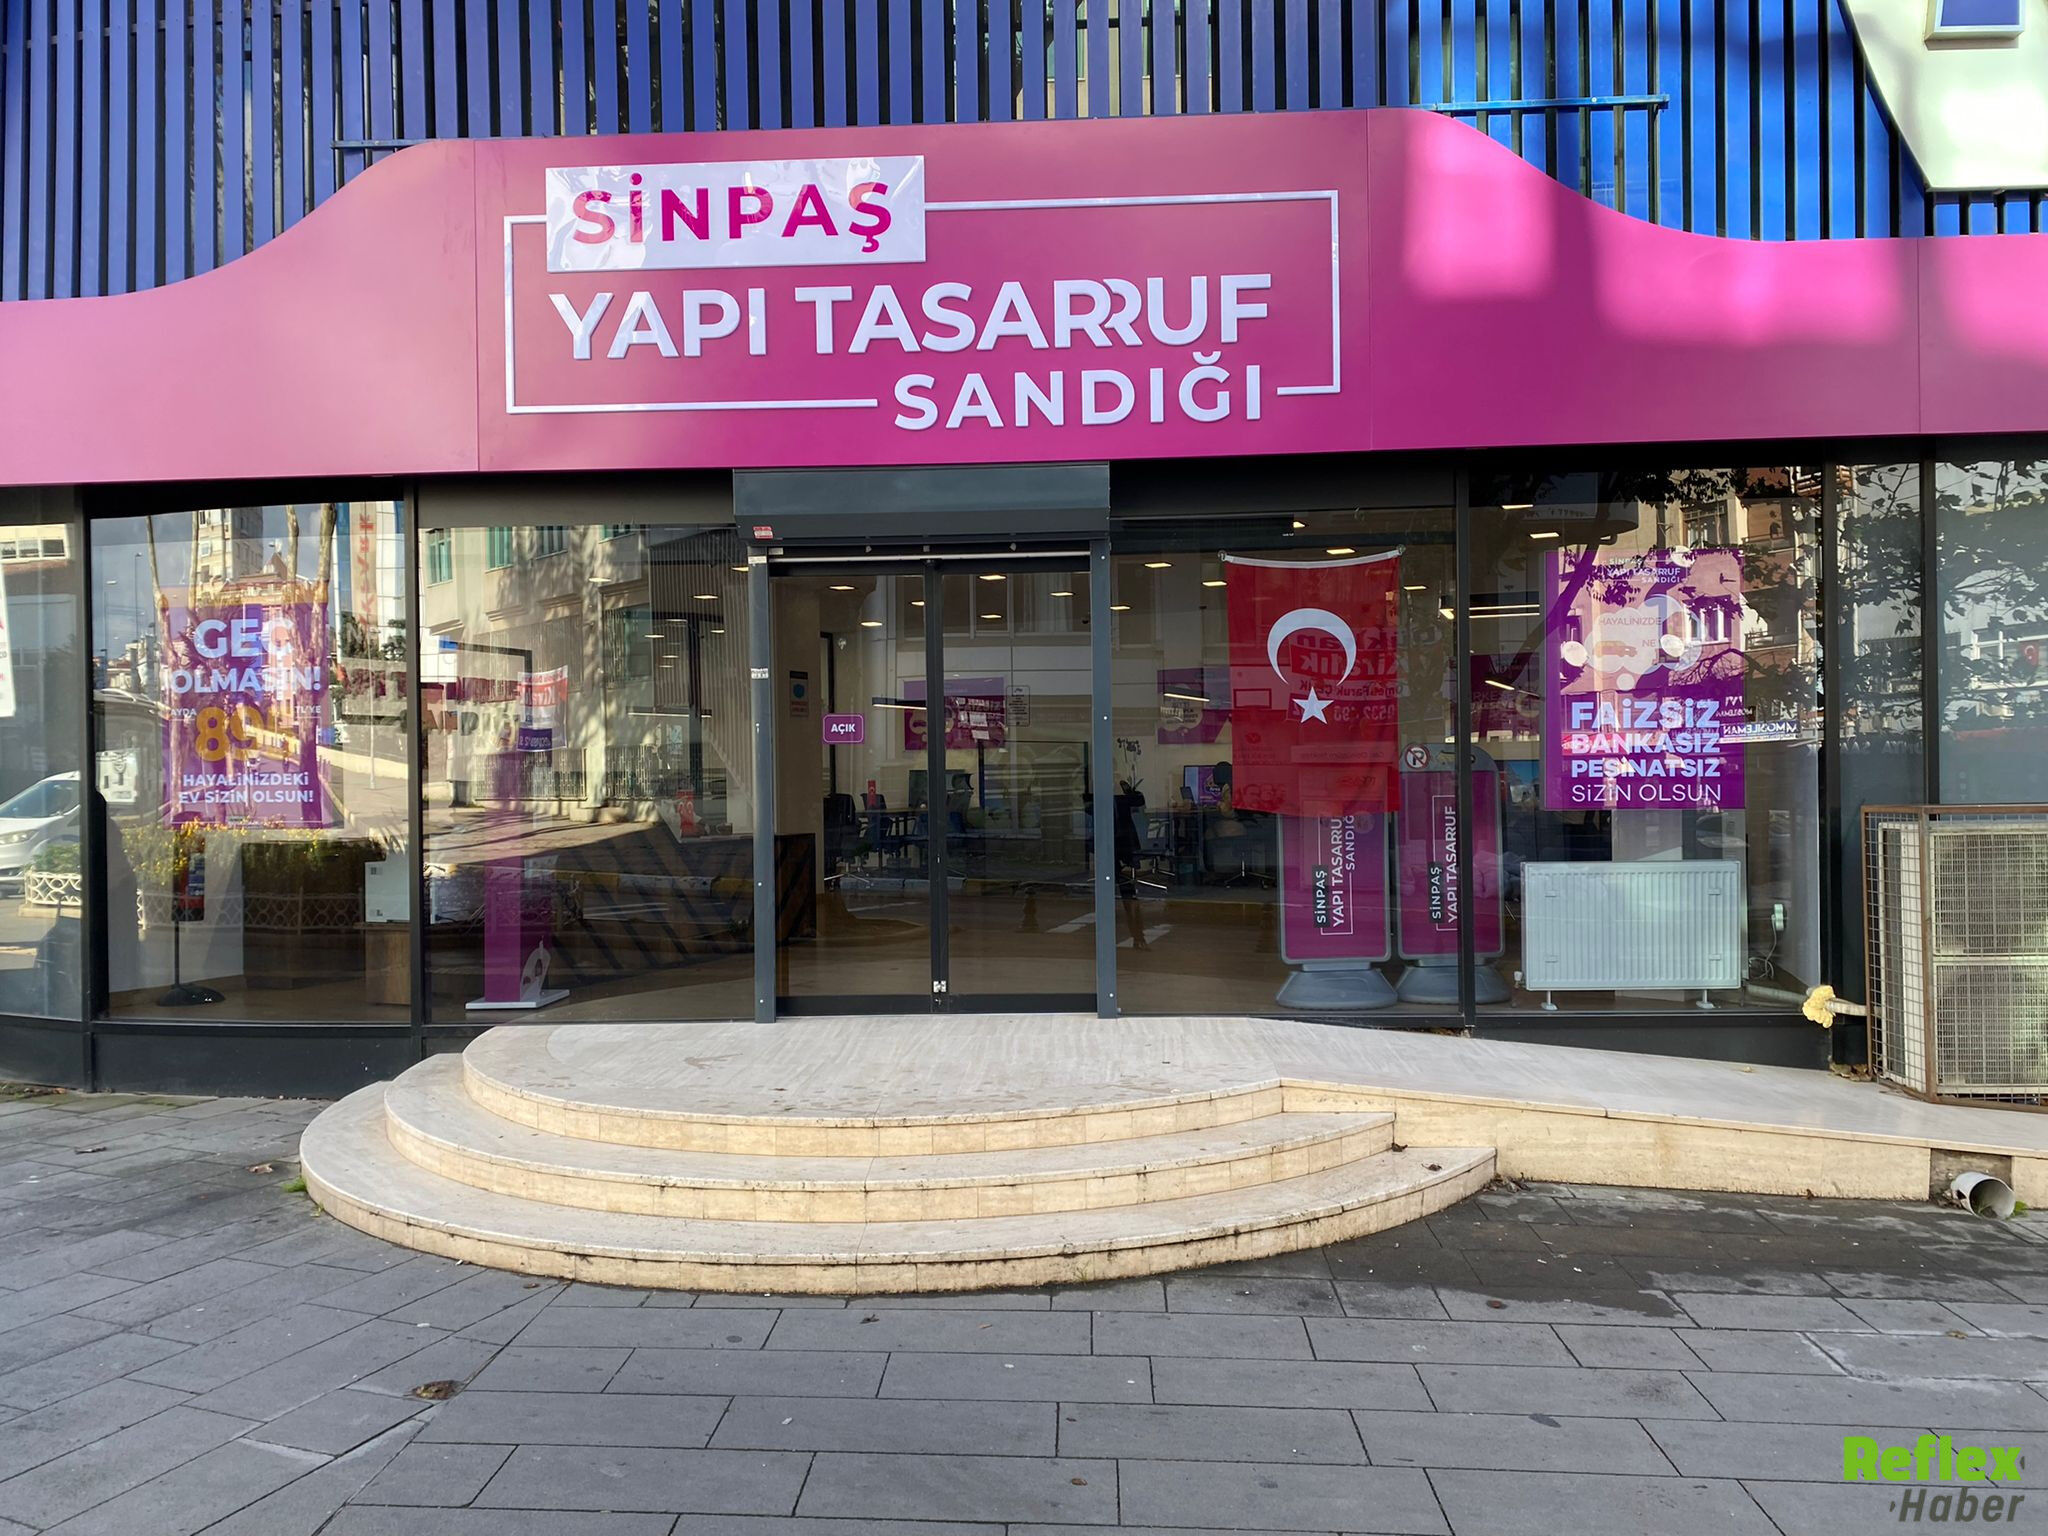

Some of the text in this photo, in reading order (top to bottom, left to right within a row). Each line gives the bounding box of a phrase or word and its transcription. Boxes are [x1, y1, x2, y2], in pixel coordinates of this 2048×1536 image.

[573, 173, 893, 253] SİNPAŞ
[548, 273, 1273, 361] YAPI TASARRUF
[894, 349, 1263, 431] SANDIĞI
[830, 723, 856, 735] AÇIK
[1571, 733, 1720, 754] BANKASIZ
[179, 791, 200, 804] EV
[253, 790, 314, 803] OLSUN!
[1638, 783, 1721, 802] OLSUN
[1343, 815, 1355, 870] SANDIĞ
[1445, 806, 1458, 923] YAPI TASARRUF
[1315, 870, 1328, 924] SİNPAŞ
[1331, 818, 1345, 927] YAPI TASARRU
[1430, 867, 1443, 919] SİNPAŞ
